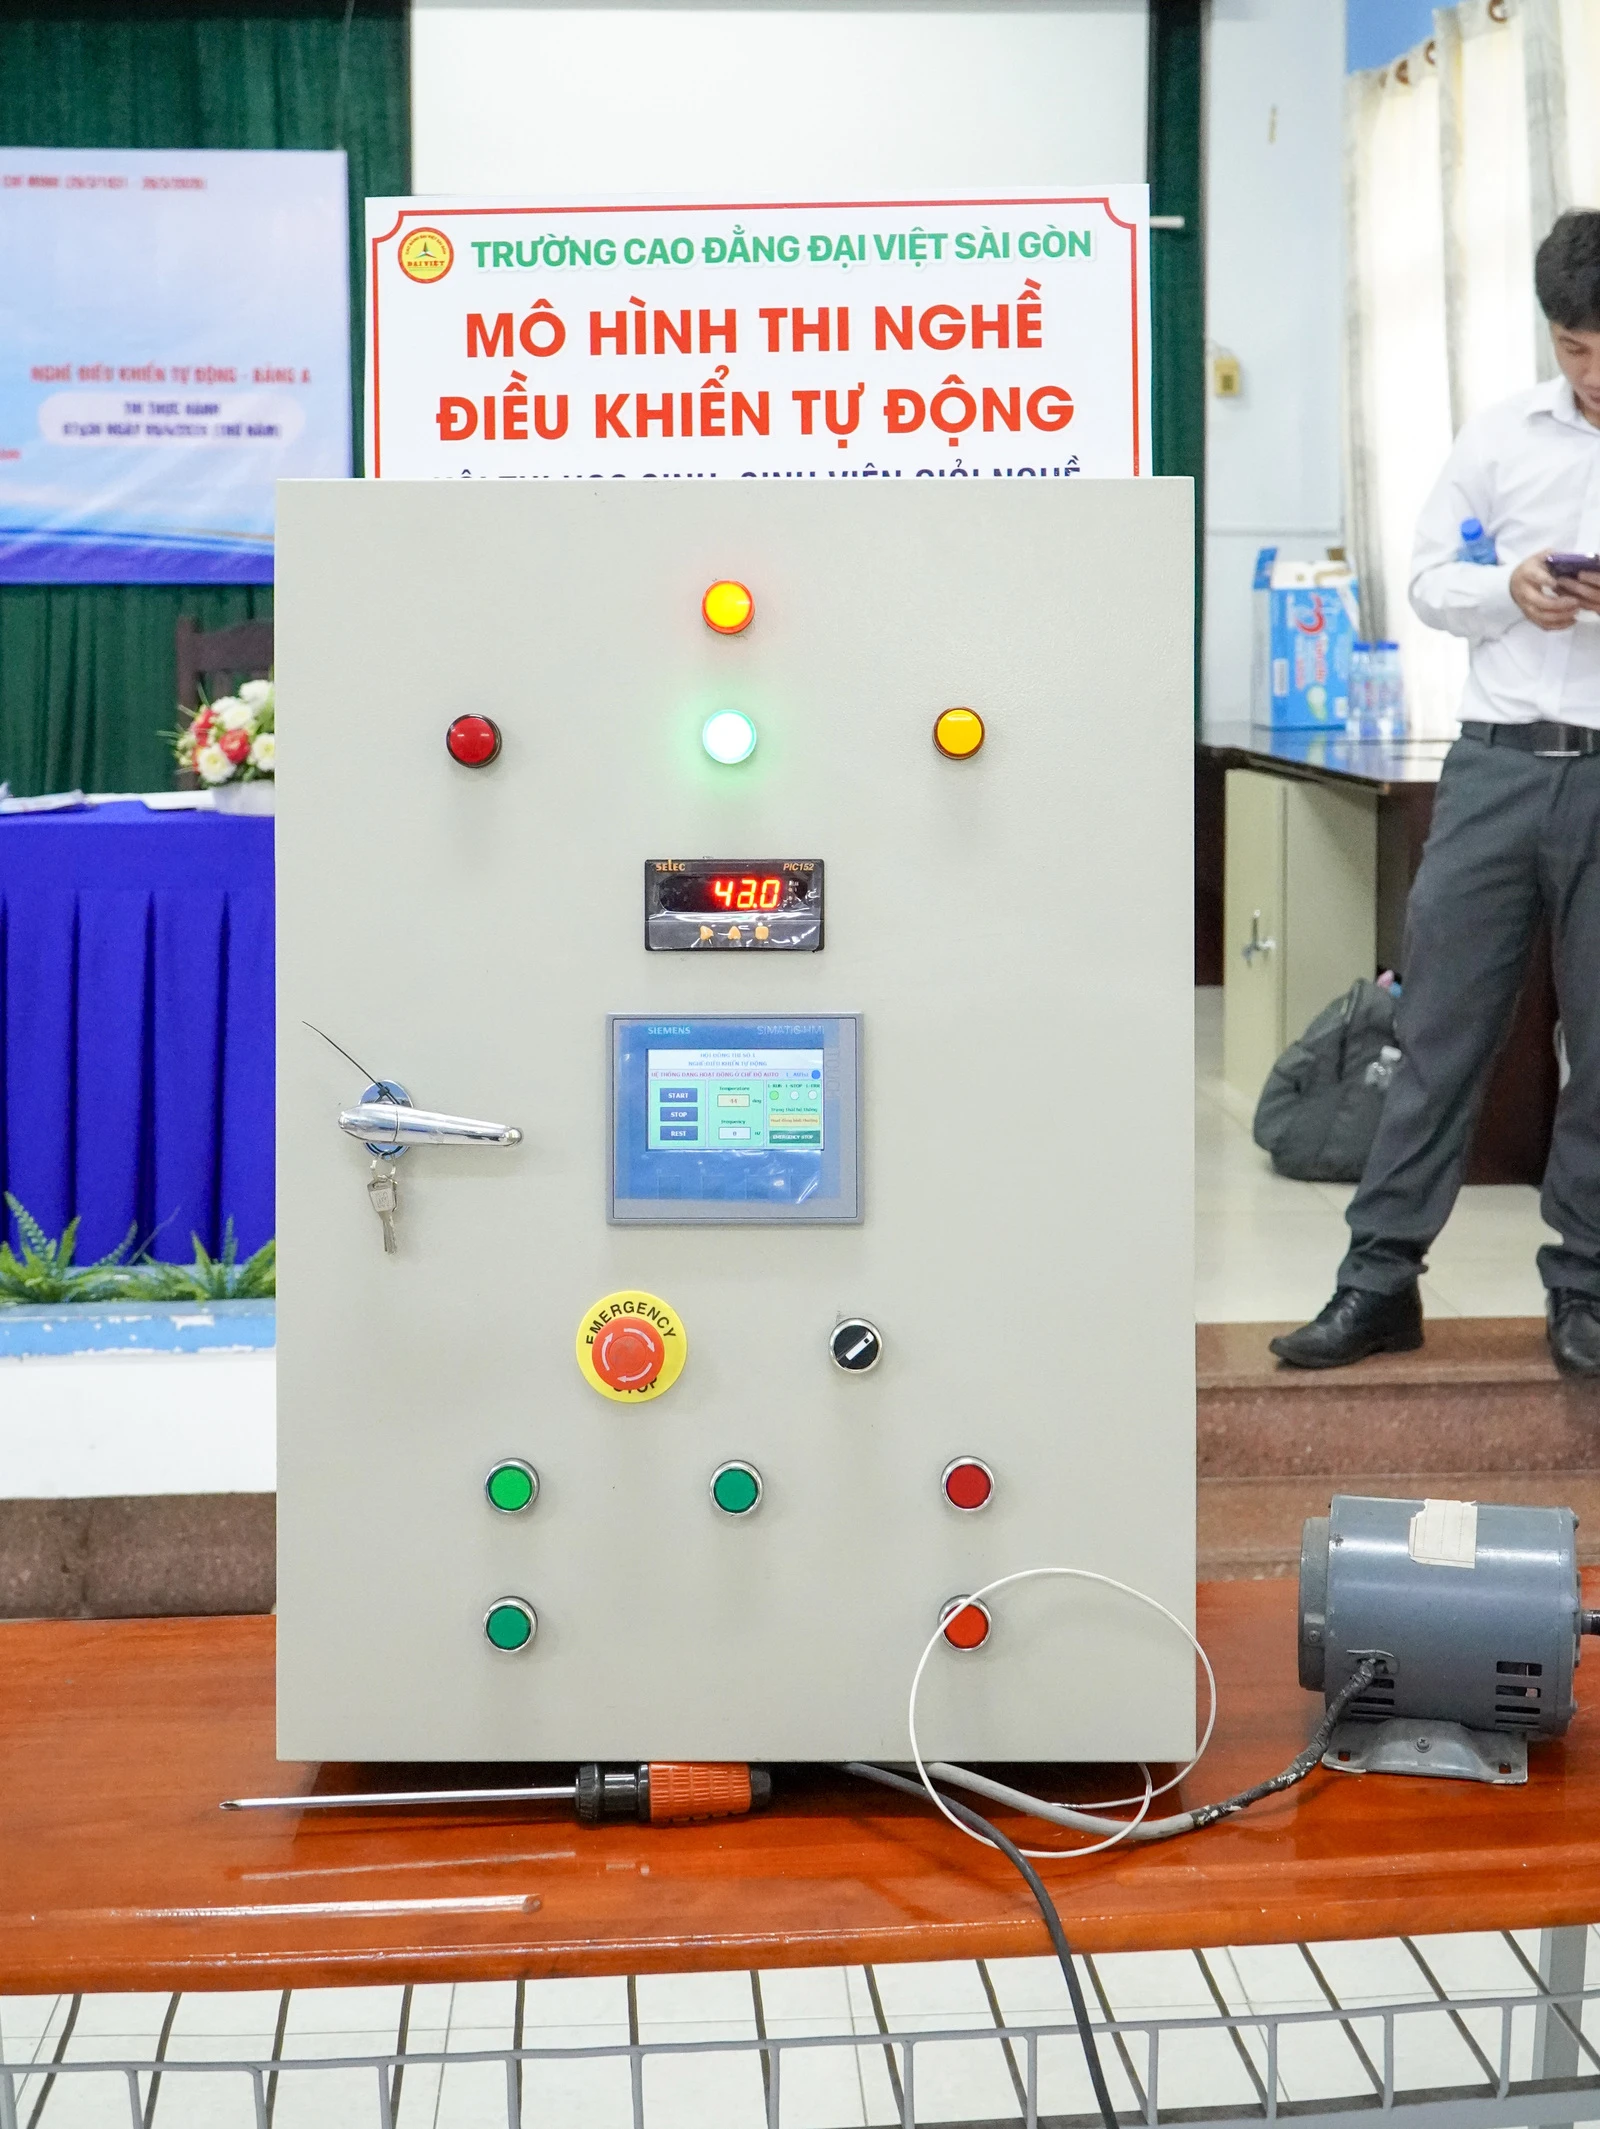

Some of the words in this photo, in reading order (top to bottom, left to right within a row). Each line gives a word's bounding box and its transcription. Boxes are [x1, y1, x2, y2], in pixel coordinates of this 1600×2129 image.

[471, 233, 617, 268] TRƯỜNG
[623, 237, 694, 266] CAO
[702, 224, 800, 263] ĐẲNG
[807, 233, 866, 269] ĐẠI
[873, 227, 948, 268] VIỆT
[955, 226, 1010, 259] SÀI
[1017, 224, 1092, 257] GÒN
[466, 298, 566, 358] MÔ
[589, 295, 737, 355] HÌNH
[759, 306, 849, 353] THI
[874, 277, 1043, 351] NGHỀ
[436, 370, 569, 442] ĐIỀU
[595, 364, 770, 439] KHIỂN
[792, 382, 865, 449] TỰ
[883, 374, 1075, 447] ĐỘNG
[783, 862, 815, 871] PIC152
[648, 1026, 691, 1035] SIEMENS
[586, 1300, 677, 1345] EMERGENCY
